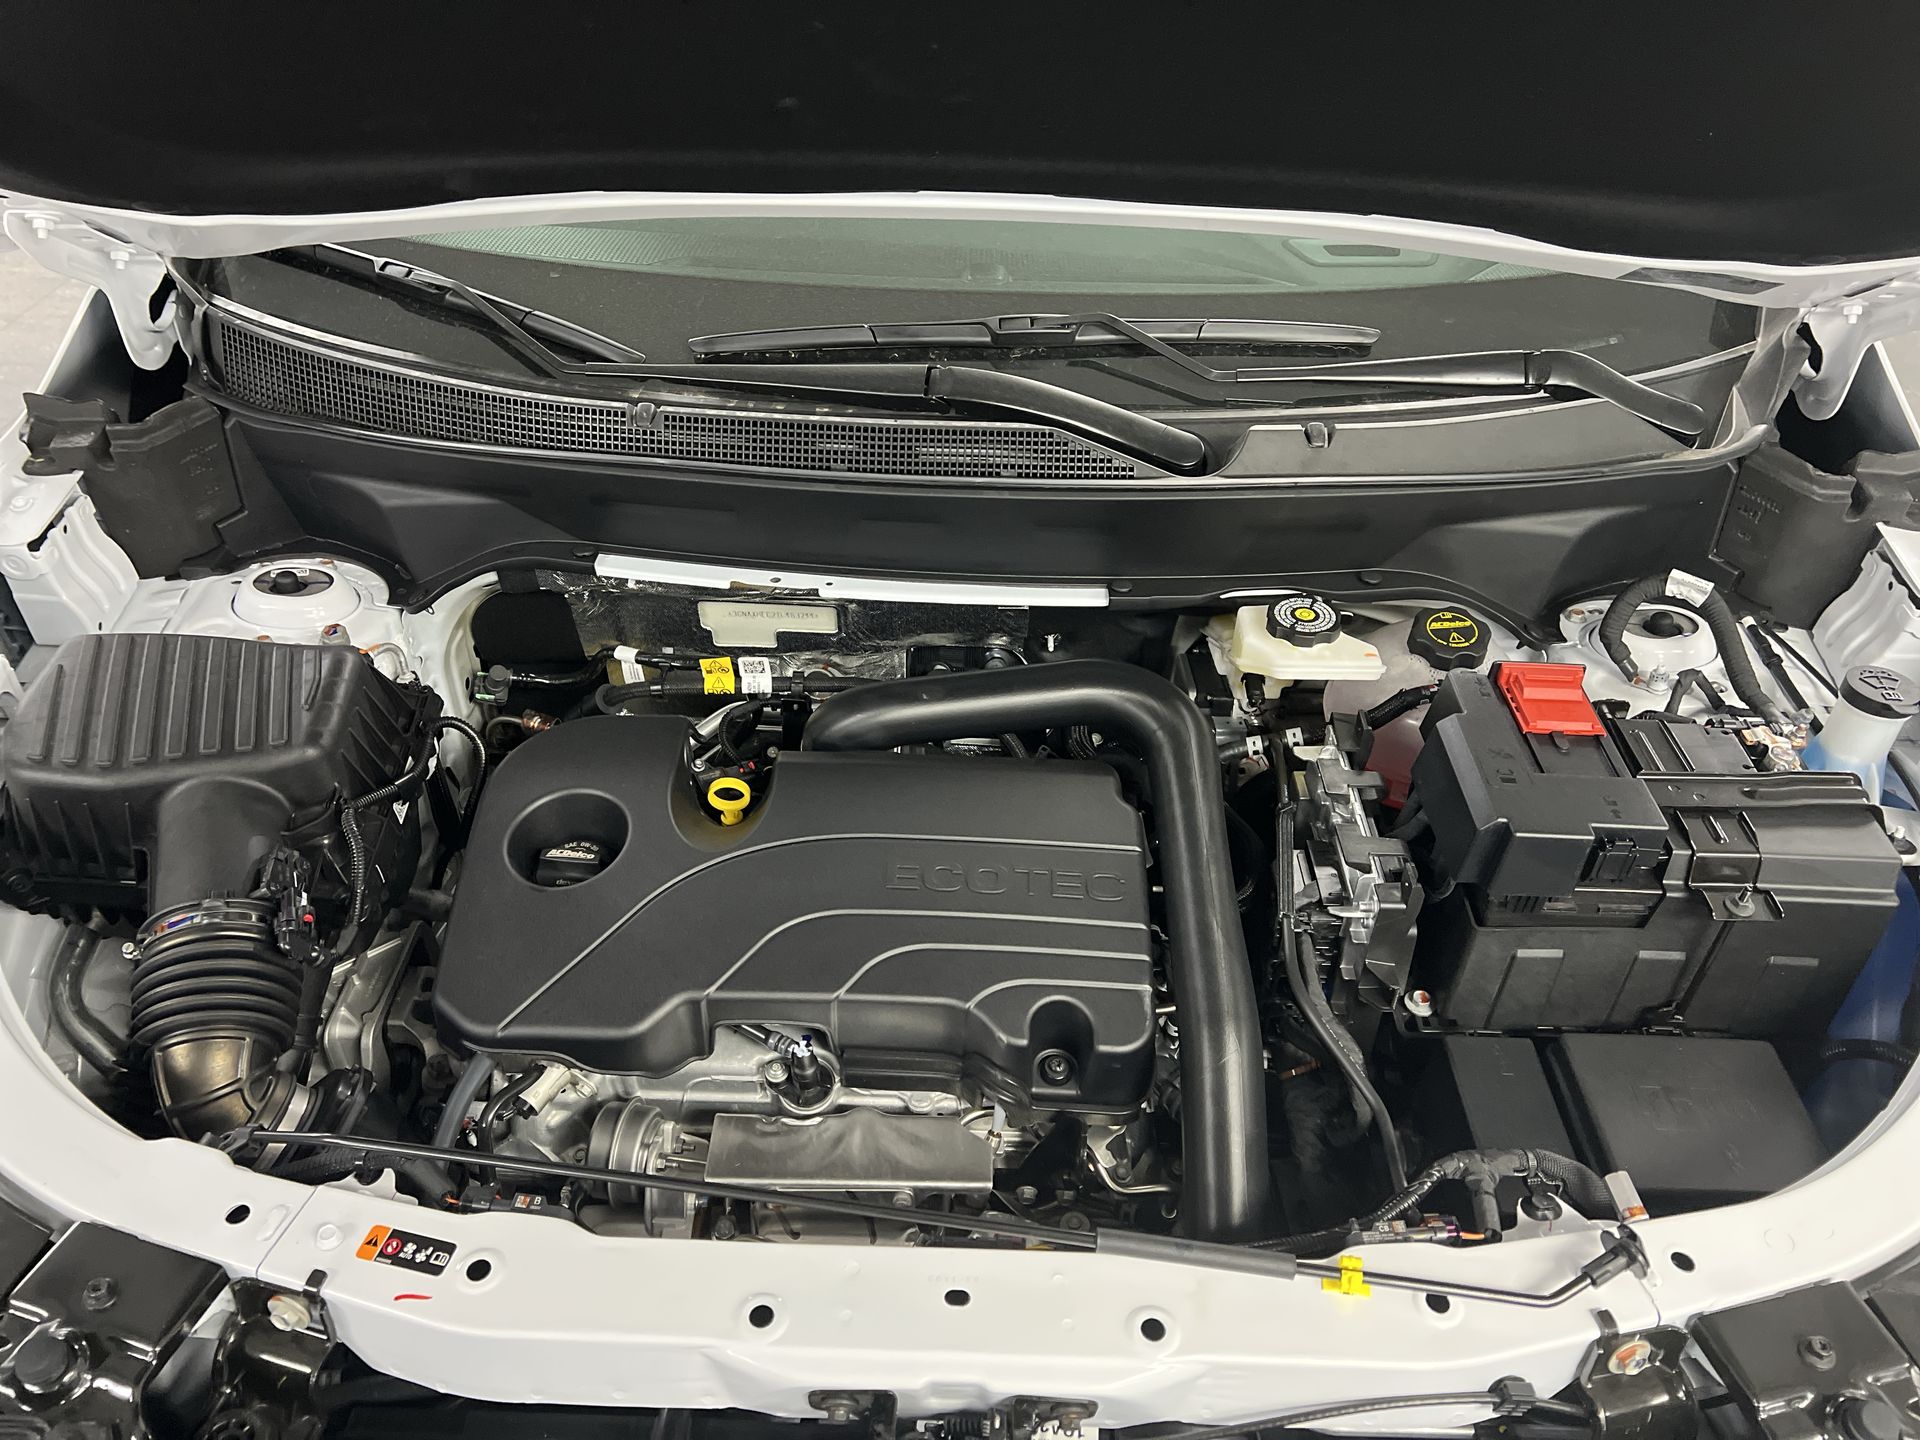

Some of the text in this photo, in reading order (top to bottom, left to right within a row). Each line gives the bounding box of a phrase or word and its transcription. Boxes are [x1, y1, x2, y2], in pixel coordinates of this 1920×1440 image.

[545, 849, 595, 859] ACDelco
[884, 863, 1126, 901] ECOTEC
[533, 1196, 542, 1205] B
[398, 1252, 413, 1260] AUTO
